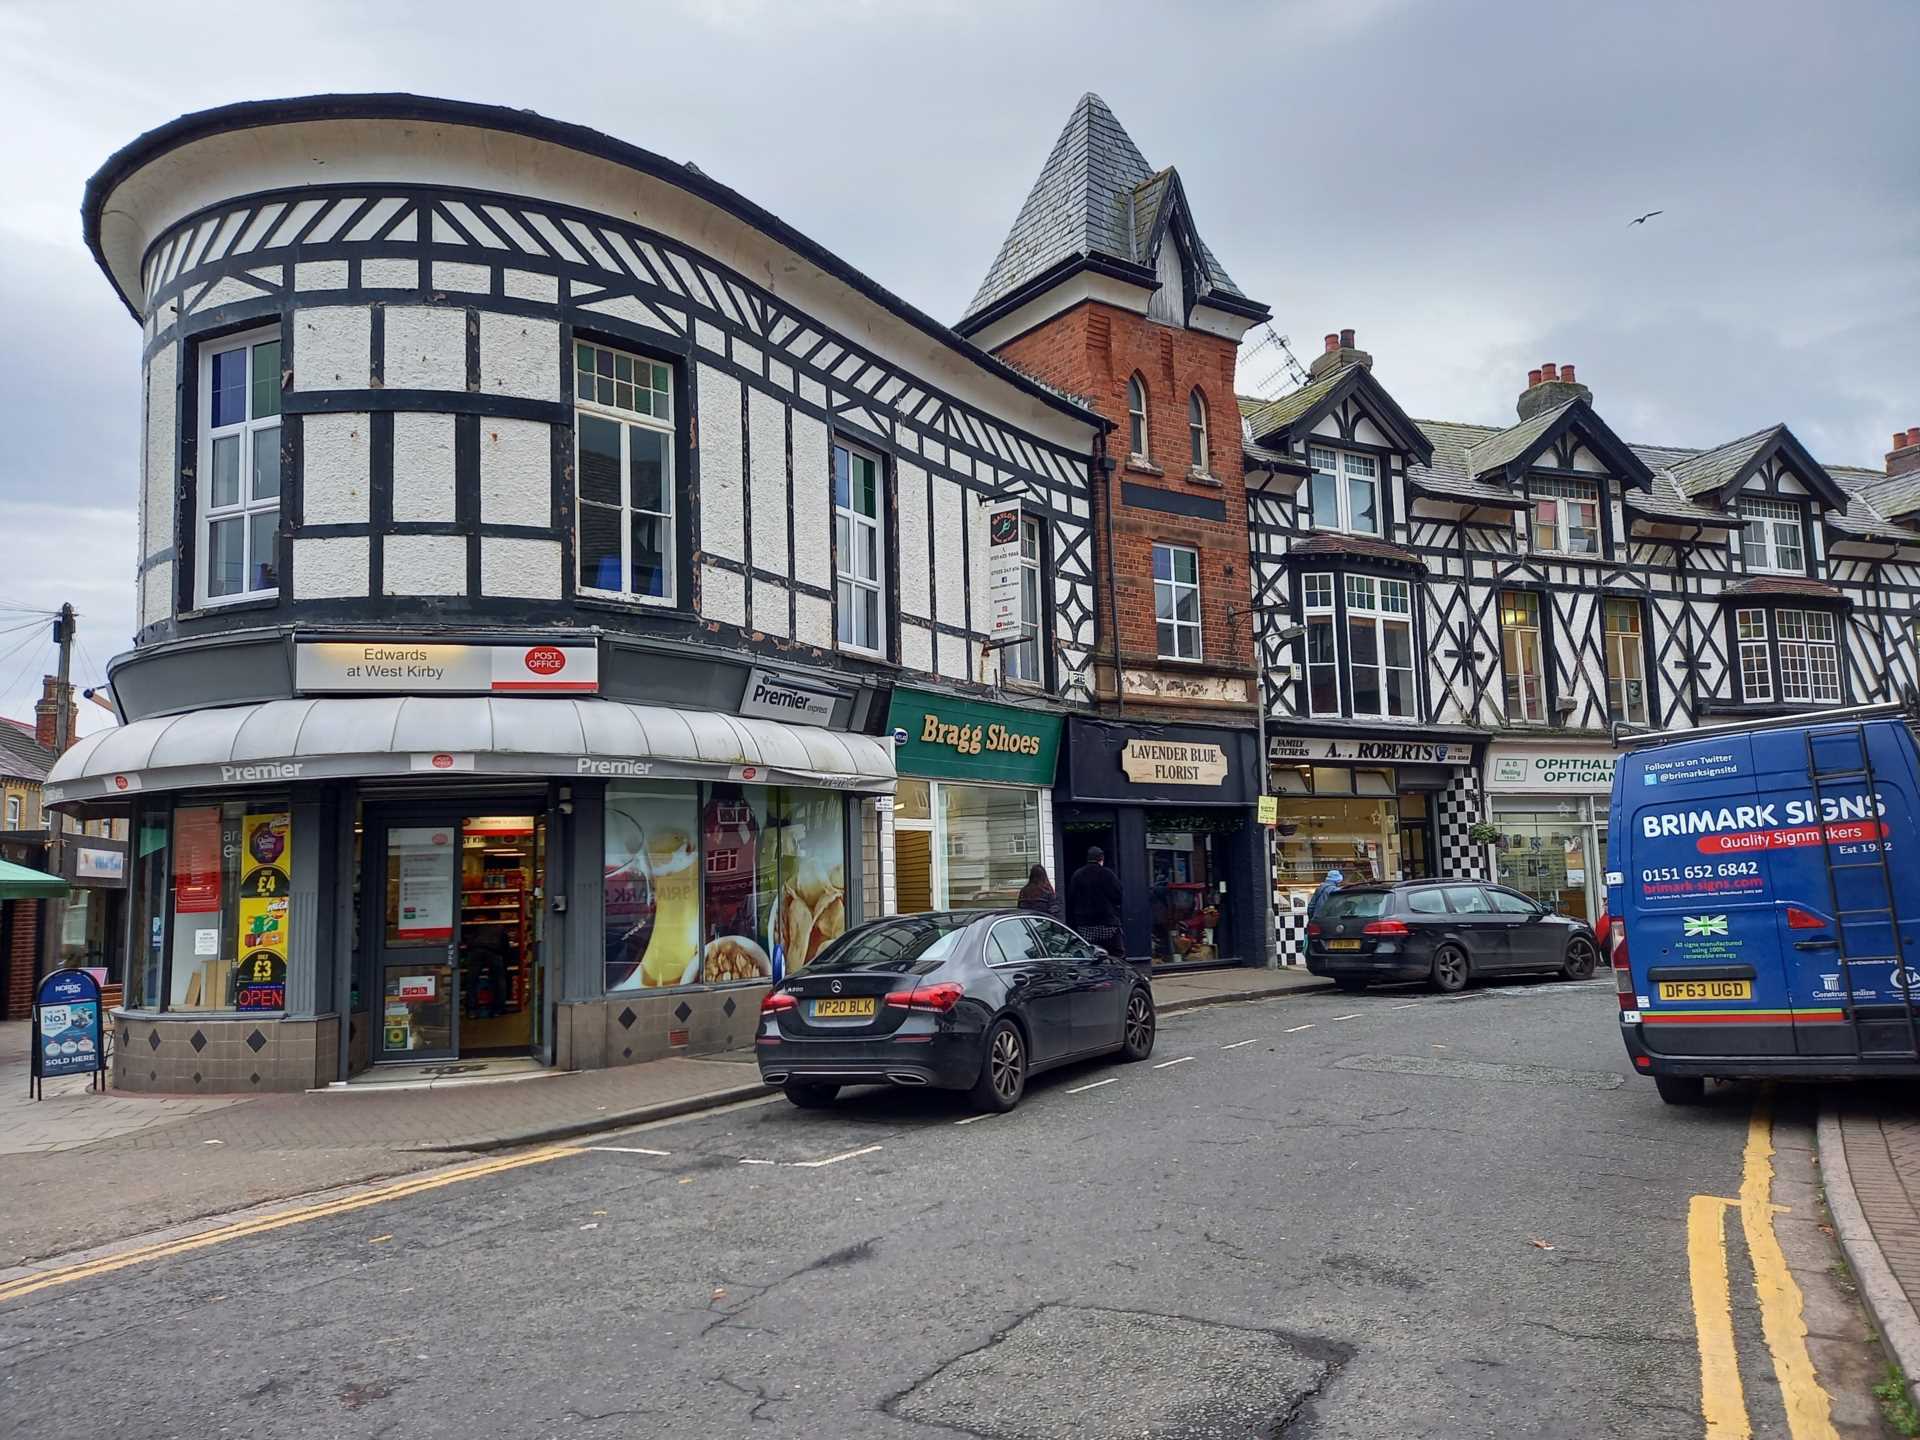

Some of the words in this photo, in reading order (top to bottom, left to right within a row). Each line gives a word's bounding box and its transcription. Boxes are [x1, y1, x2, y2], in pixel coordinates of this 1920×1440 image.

[364, 648, 427, 661] Edwards
[534, 652, 558, 660] POST
[528, 660, 561, 668] OFFICE
[347, 667, 360, 677] at
[365, 666, 402, 678] West
[408, 665, 444, 680] Kirby
[753, 685, 810, 710] Premier
[921, 714, 982, 755] Bragg
[986, 723, 1040, 755] Shoes
[1271, 748, 1310, 756] BUTCHERS
[1278, 740, 1304, 748] FAMILY
[1357, 743, 1434, 760] ROBERTS
[1130, 745, 1188, 761] LAVENDER
[1191, 748, 1218, 763] BLUE
[577, 758, 652, 775] Premier
[1644, 762, 1672, 771] Follow
[1700, 755, 1732, 764] Twitter
[221, 762, 304, 782] Premier
[1155, 764, 1200, 781] FLORIST
[1660, 765, 1737, 782] @brimarksignsltd
[1643, 803, 1778, 838] BRIMARK
[1786, 793, 1886, 824] SIGNS
[1720, 832, 1770, 850] Quality
[1839, 844, 1858, 854] Est
[1861, 842, 1892, 852] 192
[1642, 868, 1680, 882] 0151
[1684, 865, 1714, 879] 652
[1718, 862, 1758, 876] 6842
[257, 876, 276, 892] £4
[1642, 878, 1763, 894] brimark-signs.com
[254, 960, 272, 976] £3
[56, 984, 82, 992] NORDIC
[1666, 984, 1707, 998] DF63
[1711, 982, 1744, 997] UGD
[239, 990, 282, 1006] OPEN
[850, 1000, 872, 1013] BLK
[44, 1014, 66, 1023] No.1
[46, 1057, 70, 1066] SOLD
[72, 1054, 95, 1063] HERE
